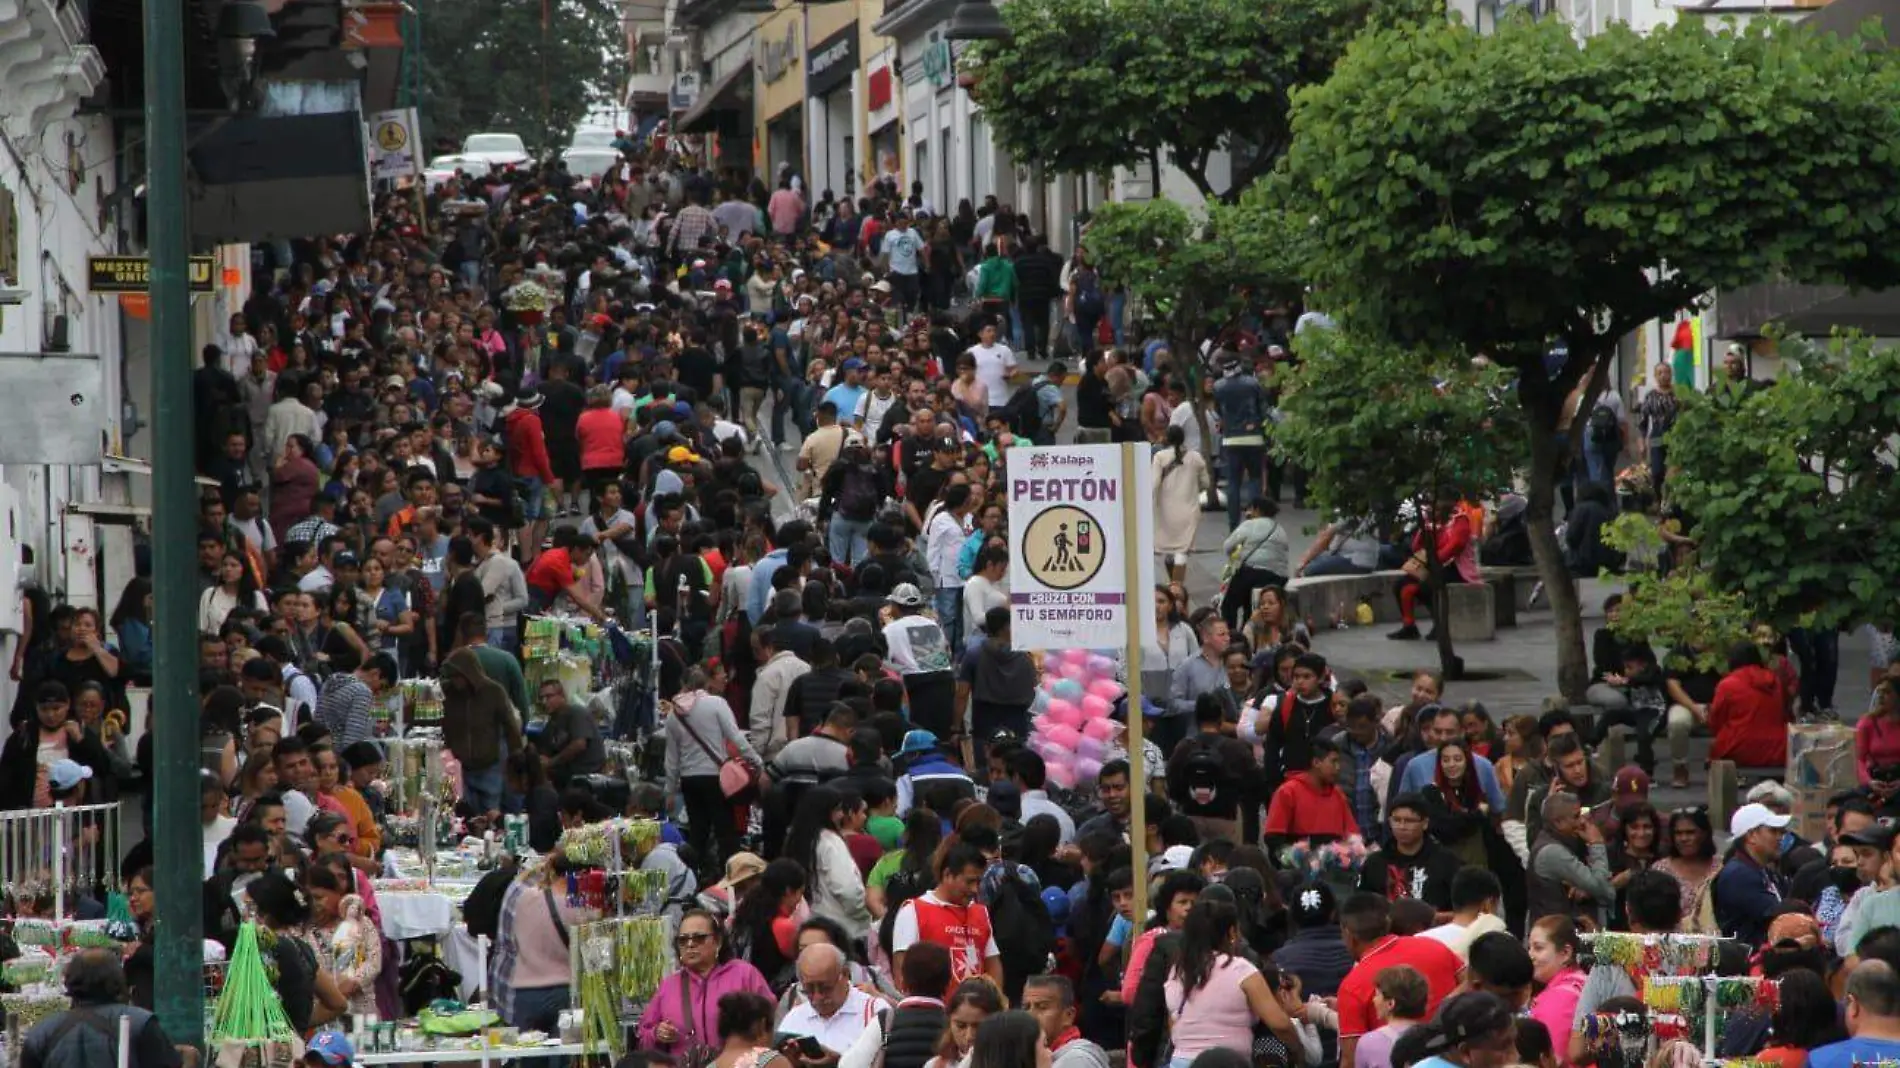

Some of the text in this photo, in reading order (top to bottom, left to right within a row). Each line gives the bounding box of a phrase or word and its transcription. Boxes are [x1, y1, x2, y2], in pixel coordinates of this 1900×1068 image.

[93, 262, 150, 272] WESTER
[1051, 455, 1094, 466] Xalapa
[1014, 471, 1117, 501] PEATÓN
[1030, 592, 1095, 604] CRUZA CON
[1017, 609, 1034, 621] TU
